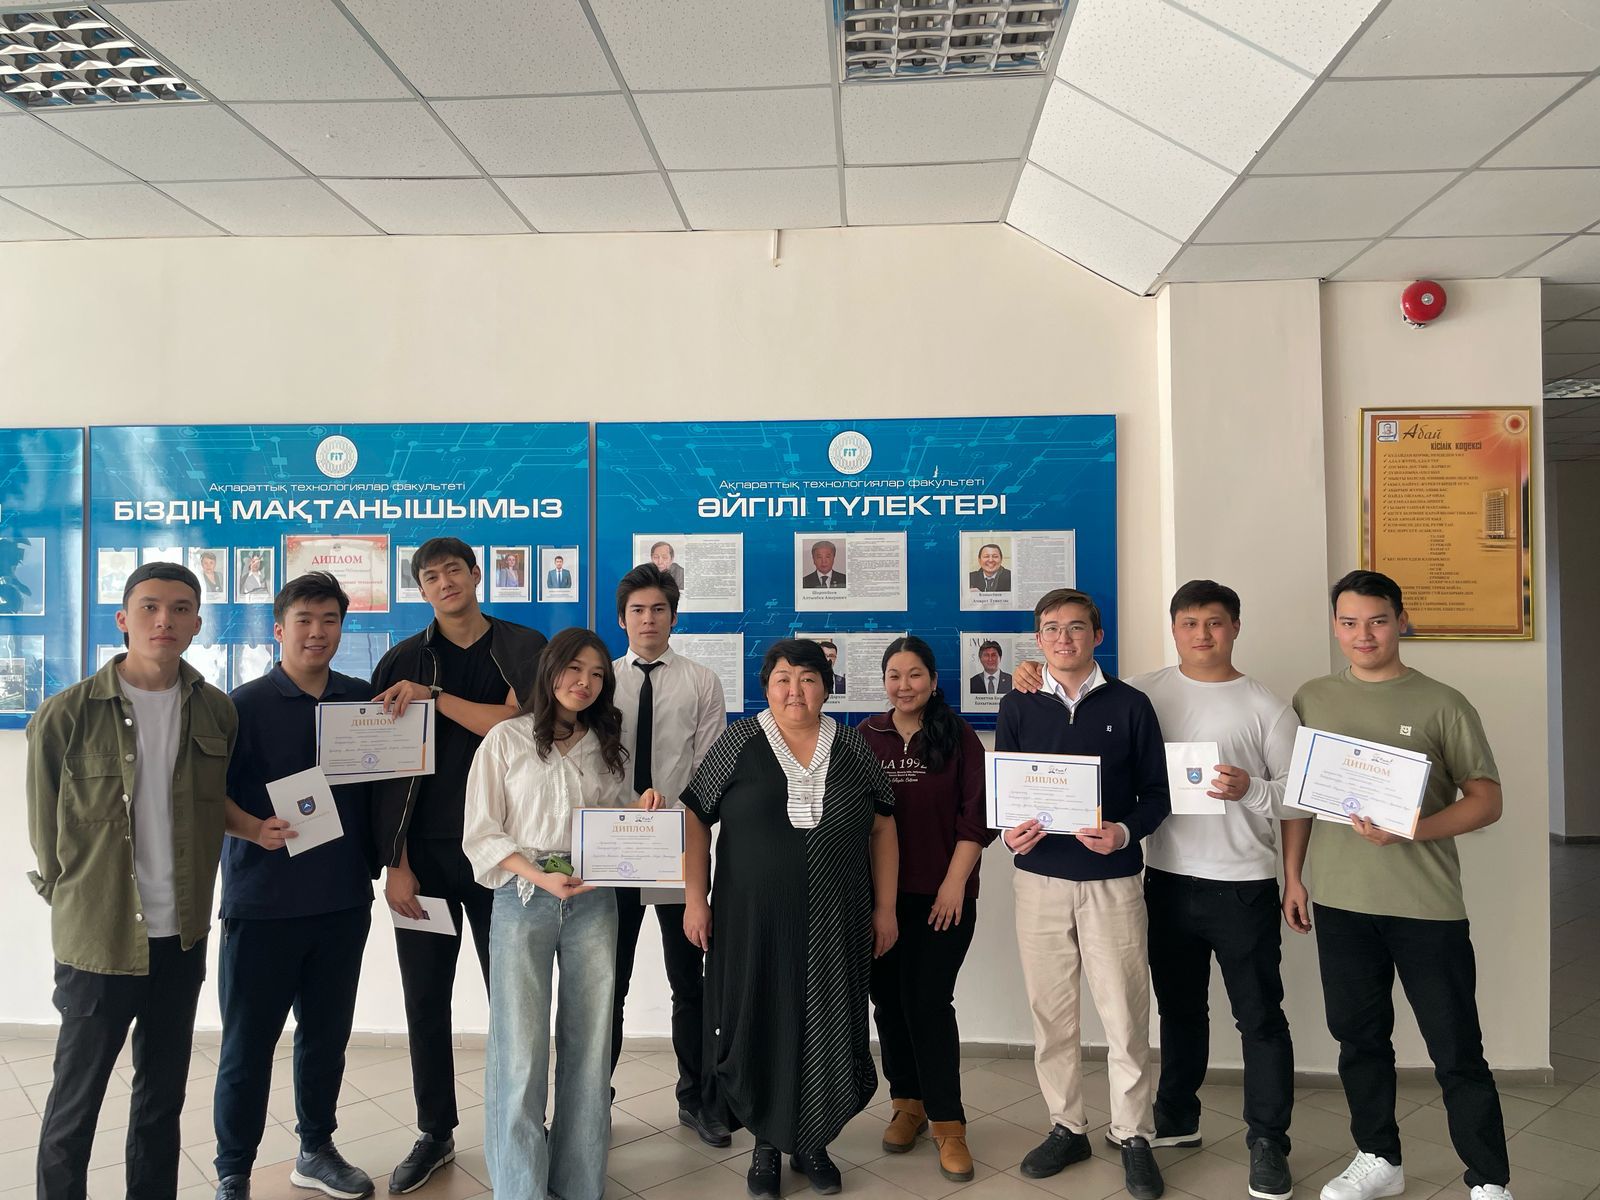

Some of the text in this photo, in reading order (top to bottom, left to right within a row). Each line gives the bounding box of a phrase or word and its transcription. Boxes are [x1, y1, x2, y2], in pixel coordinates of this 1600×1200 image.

[1402, 423, 1442, 439] Абай
[208, 481, 466, 493] Ақпараттық технологиялар факультеті
[719, 477, 985, 490] Ақпараттық технологиялар факультеті
[114, 498, 563, 524] БІЗДІҢ МАҚТАНЫШЫМЫЗ
[697, 492, 1006, 518] ӘЙГІЛІ ТҮЛЕКТЕРІ
[311, 555, 363, 566] ДИПЛОМ
[351, 718, 396, 727] ДИПЛОМ
[1343, 758, 1391, 777] ДИПЛОМ
[1024, 775, 1068, 785] ДИПЛОМ
[612, 825, 655, 833] ДИПЛОМ
